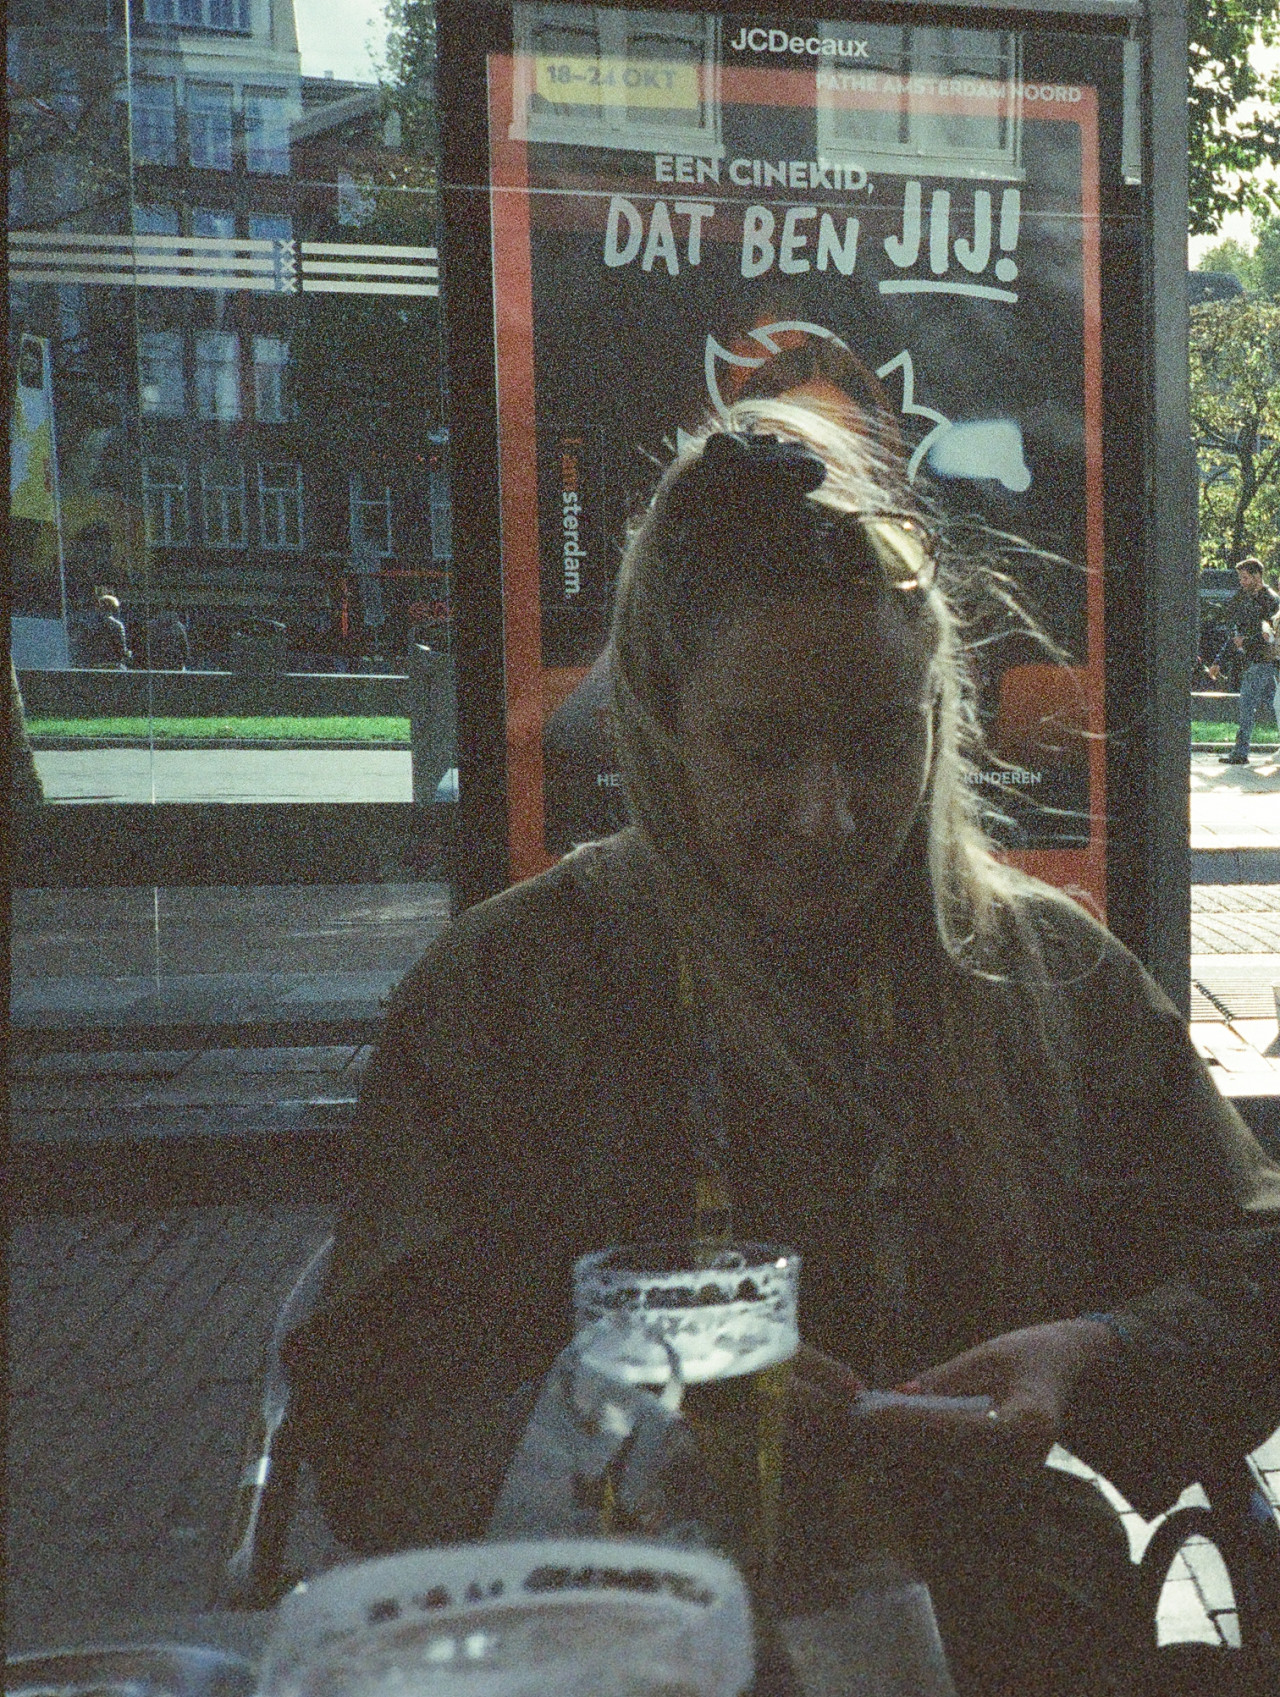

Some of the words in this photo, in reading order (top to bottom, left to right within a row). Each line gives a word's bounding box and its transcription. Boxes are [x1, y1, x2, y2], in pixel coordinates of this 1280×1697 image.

[730, 27, 869, 58] JCDecaux
[621, 66, 676, 90] OKT
[881, 76, 1006, 99] AMSTERDAM
[1010, 85, 1083, 103] NOORD
[654, 155, 720, 185] EEN
[728, 159, 875, 194] CINEKID,
[603, 196, 715, 276] DAT
[740, 205, 860, 279] BEN
[883, 179, 1022, 284] JIJ!
[963, 770, 1043, 786] KINDEREN
